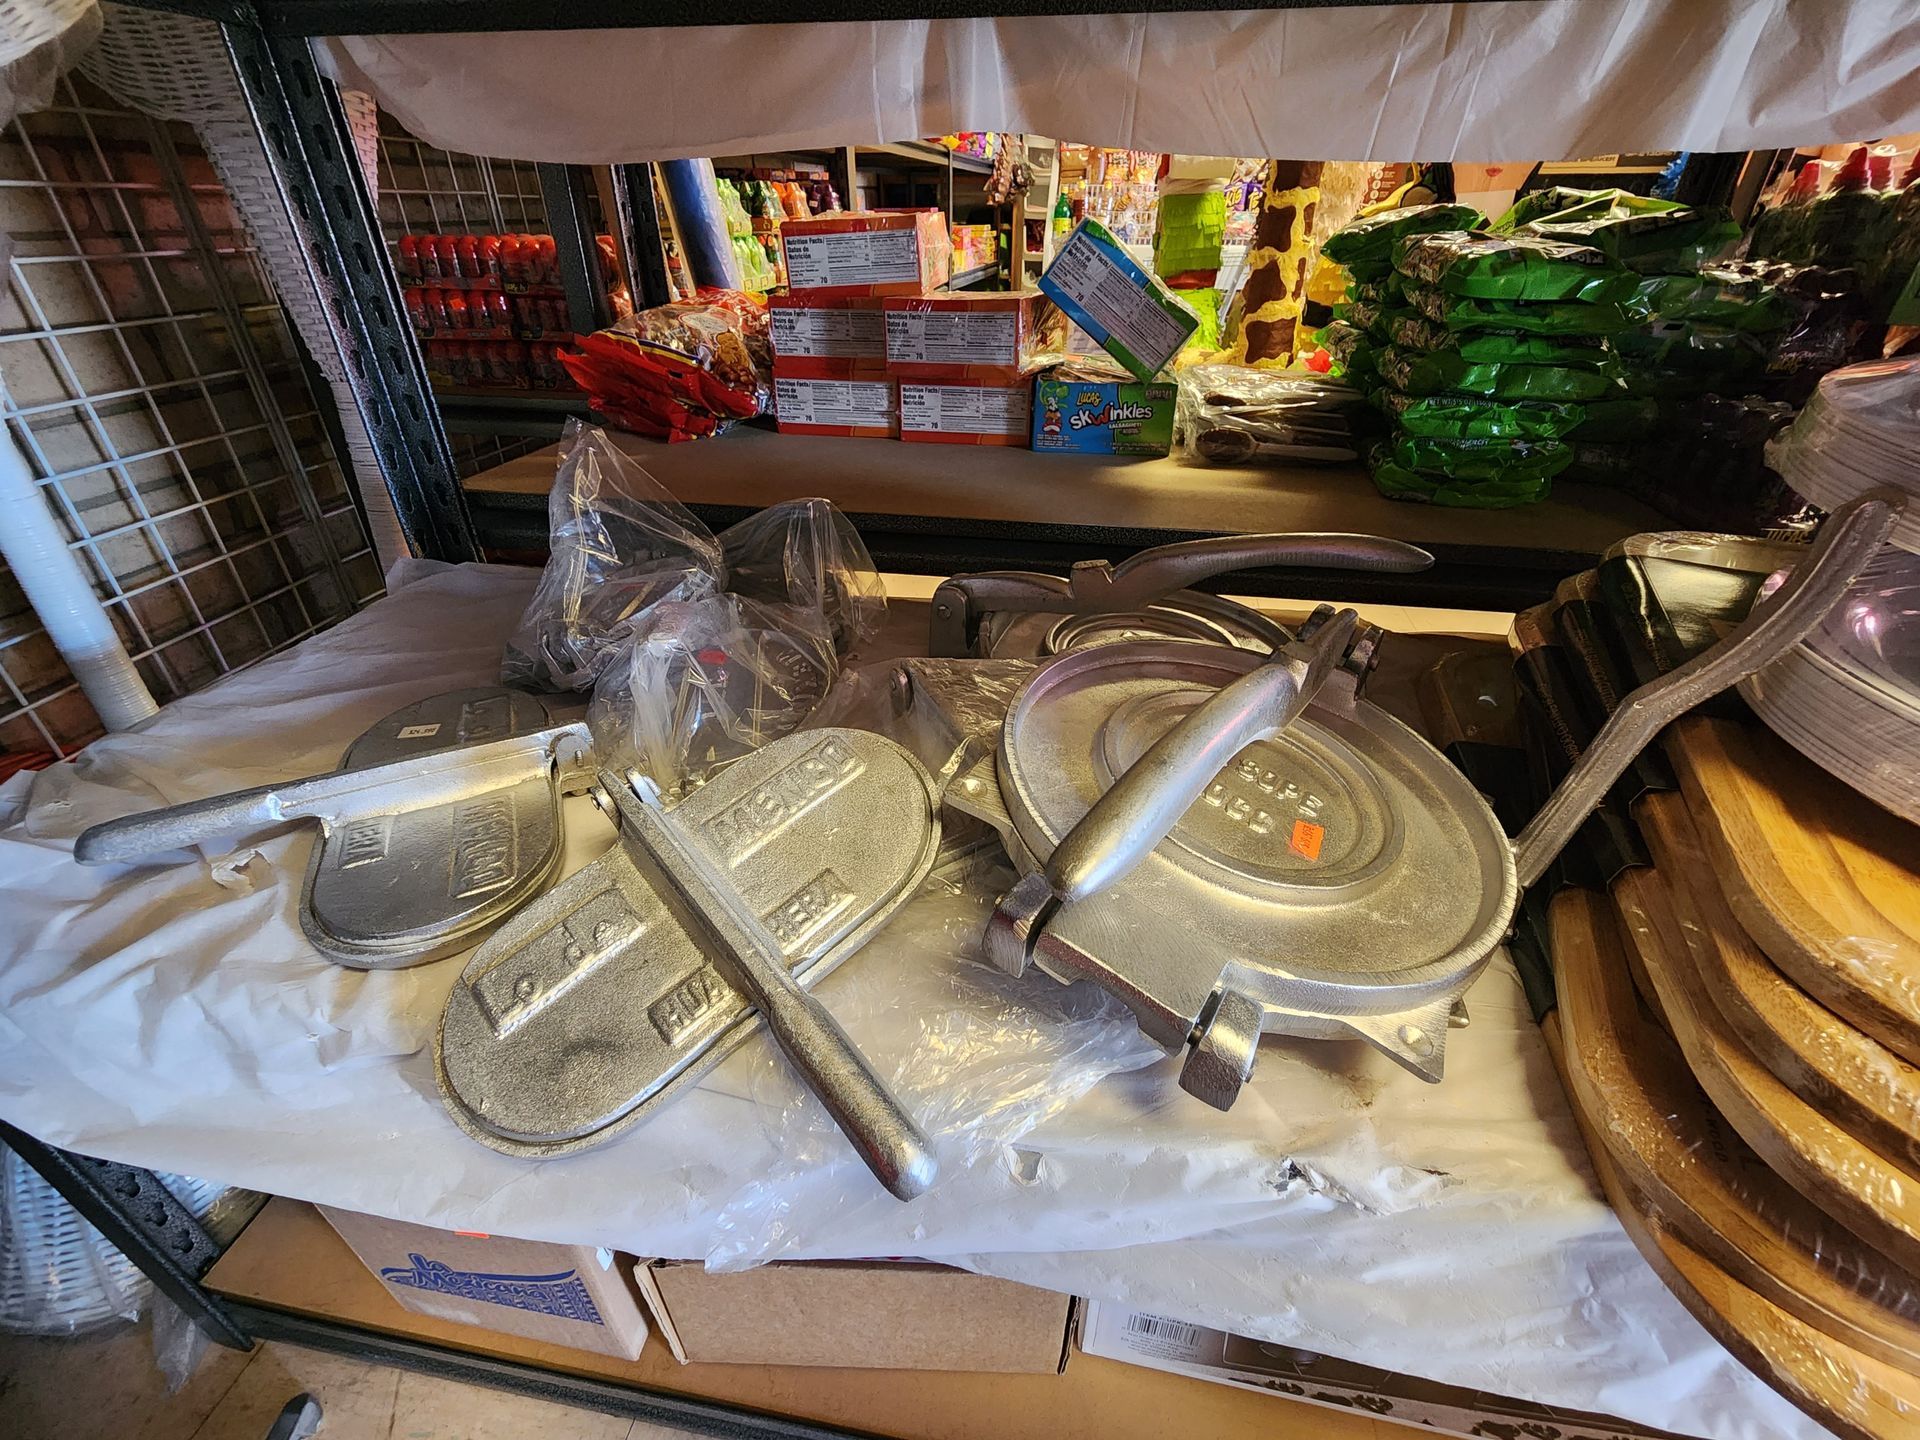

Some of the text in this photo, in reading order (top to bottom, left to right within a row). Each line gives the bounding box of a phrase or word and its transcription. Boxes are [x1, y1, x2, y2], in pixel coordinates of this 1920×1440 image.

[1072, 242, 1092, 263] Datos de
[1076, 235, 1097, 256] Nutrition
[1076, 292, 1085, 302] 70
[1077, 391, 1102, 406] LUCAS
[412, 1269, 550, 1300] Mexicana
